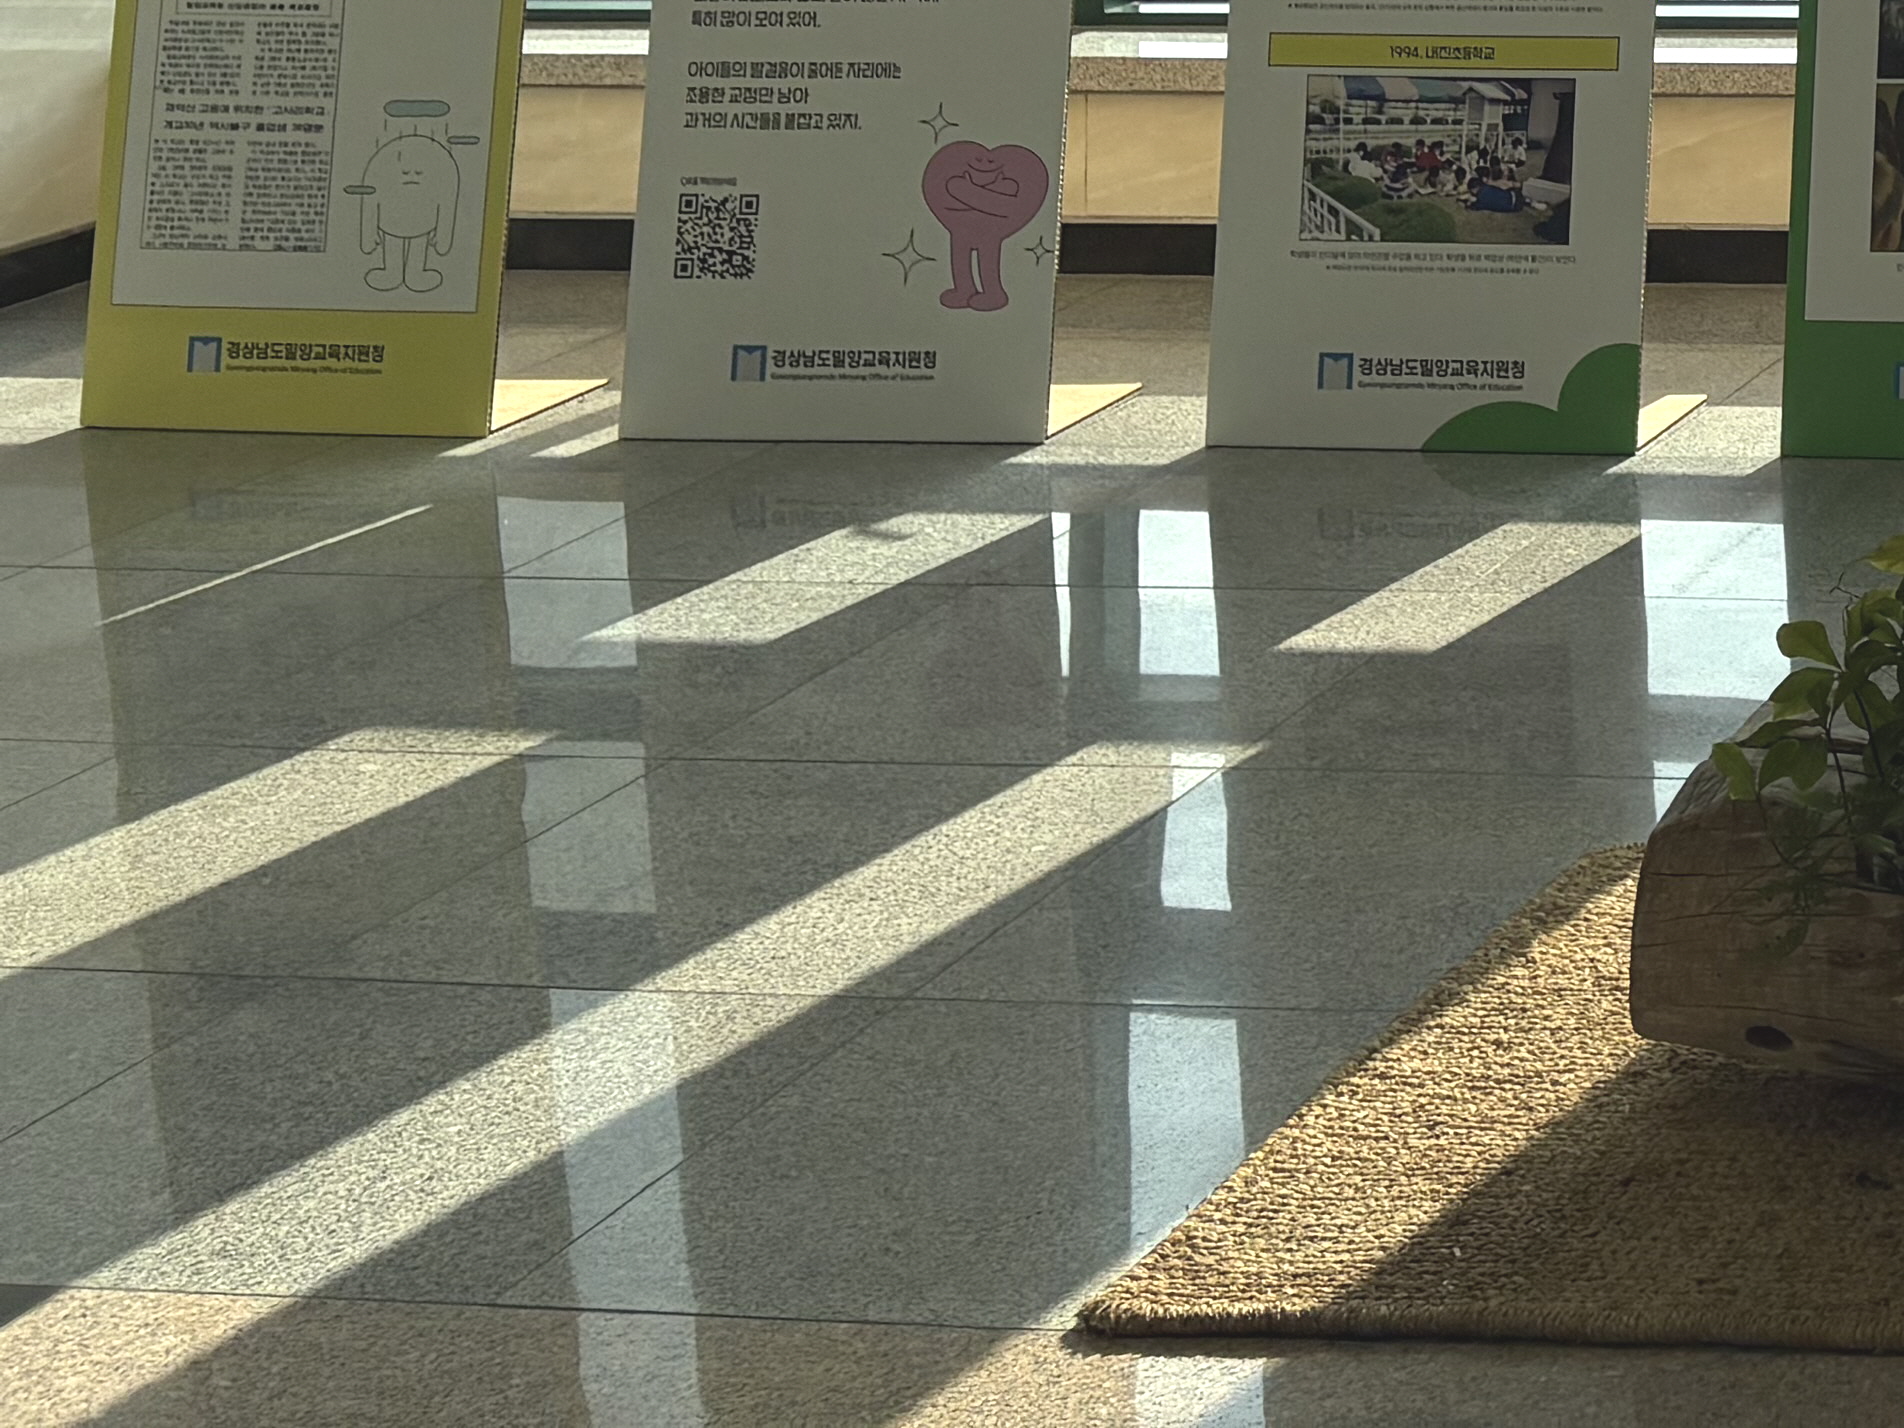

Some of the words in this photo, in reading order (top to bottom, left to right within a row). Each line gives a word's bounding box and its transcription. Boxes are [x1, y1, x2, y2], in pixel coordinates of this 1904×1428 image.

[686, 86, 725, 104] 조용한
[728, 87, 774, 104] 교정만
[778, 87, 809, 104] 남아
[226, 341, 385, 363] 경상남도밀양교육지원청
[771, 349, 936, 369] 경상남도밀양교육지원청
[1358, 358, 1525, 380] 경상남도밀양교육지원청
